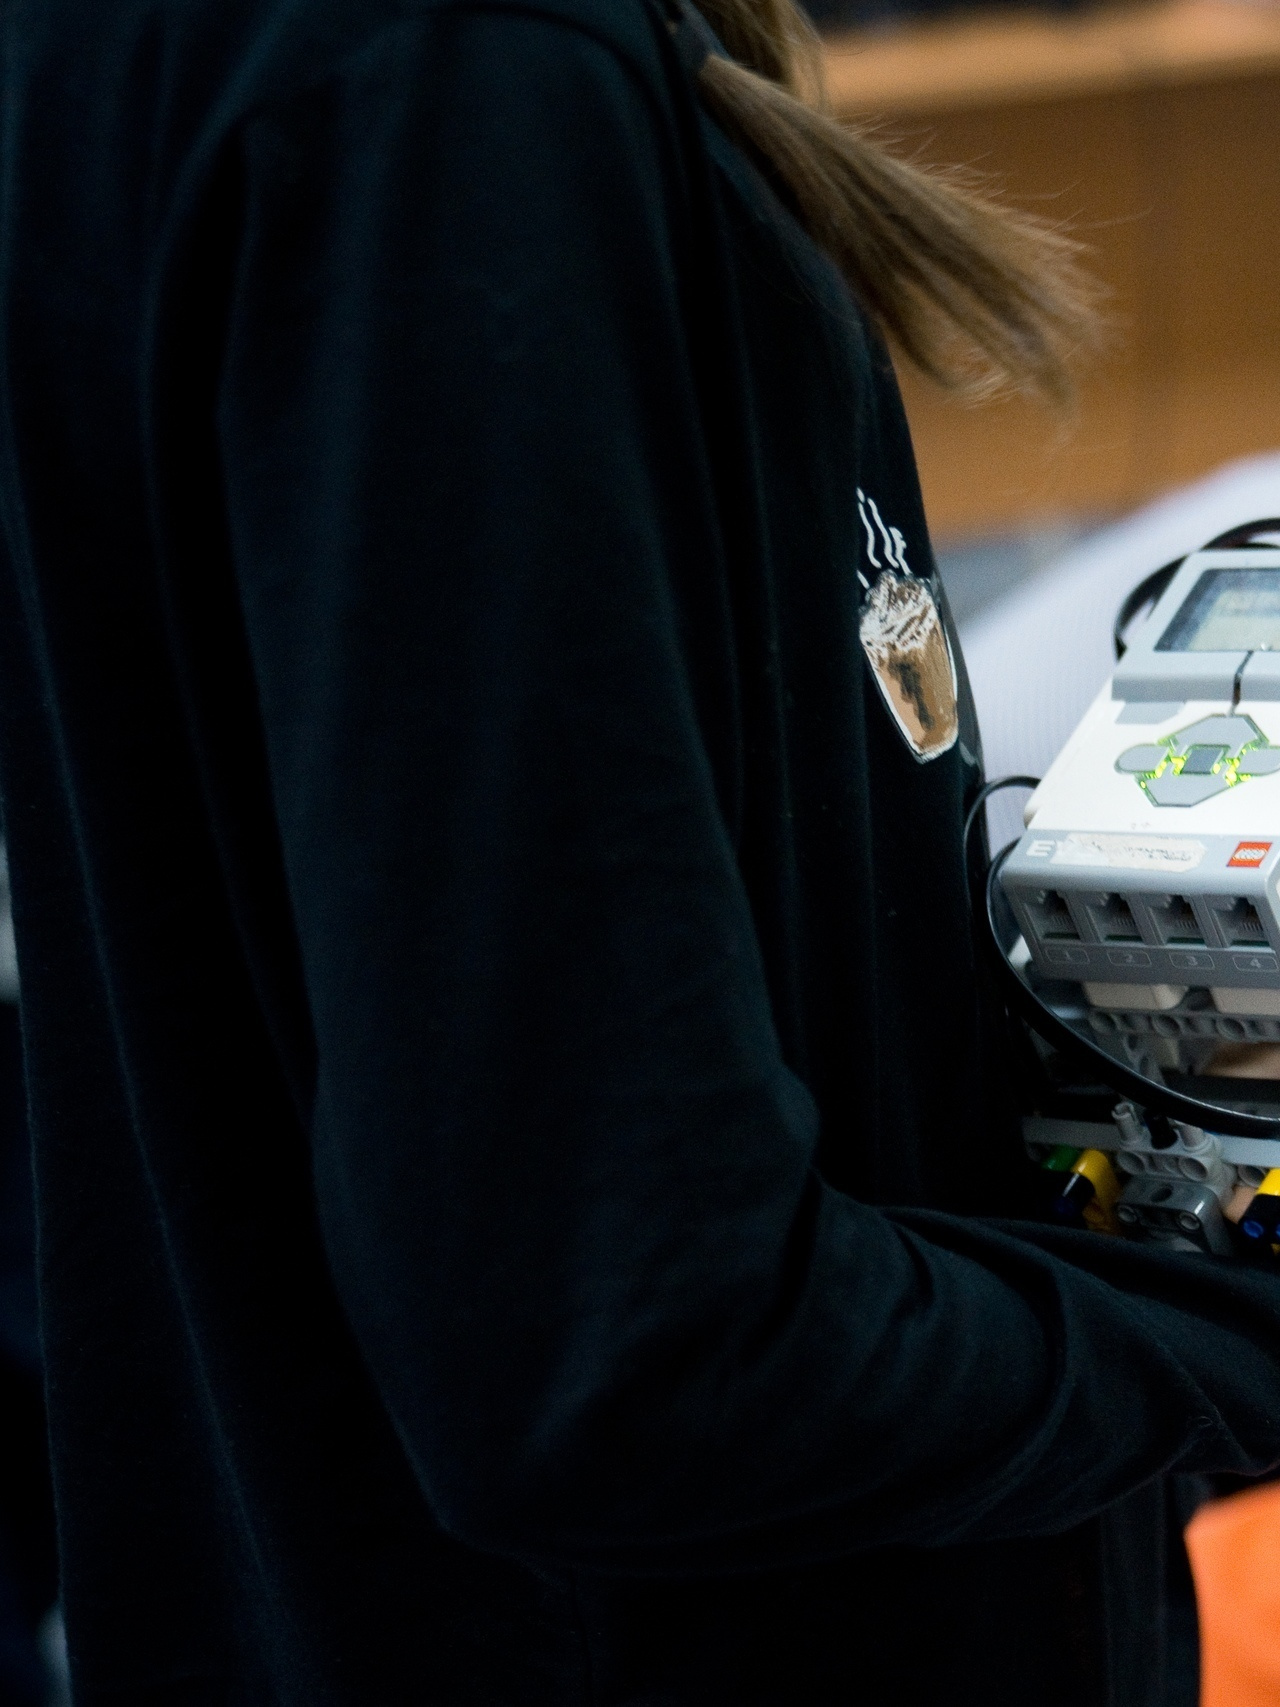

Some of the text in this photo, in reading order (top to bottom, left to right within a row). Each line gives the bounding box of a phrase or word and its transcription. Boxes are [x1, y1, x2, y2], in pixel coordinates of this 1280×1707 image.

[1063, 950, 1262, 969] 1 2 3 4
